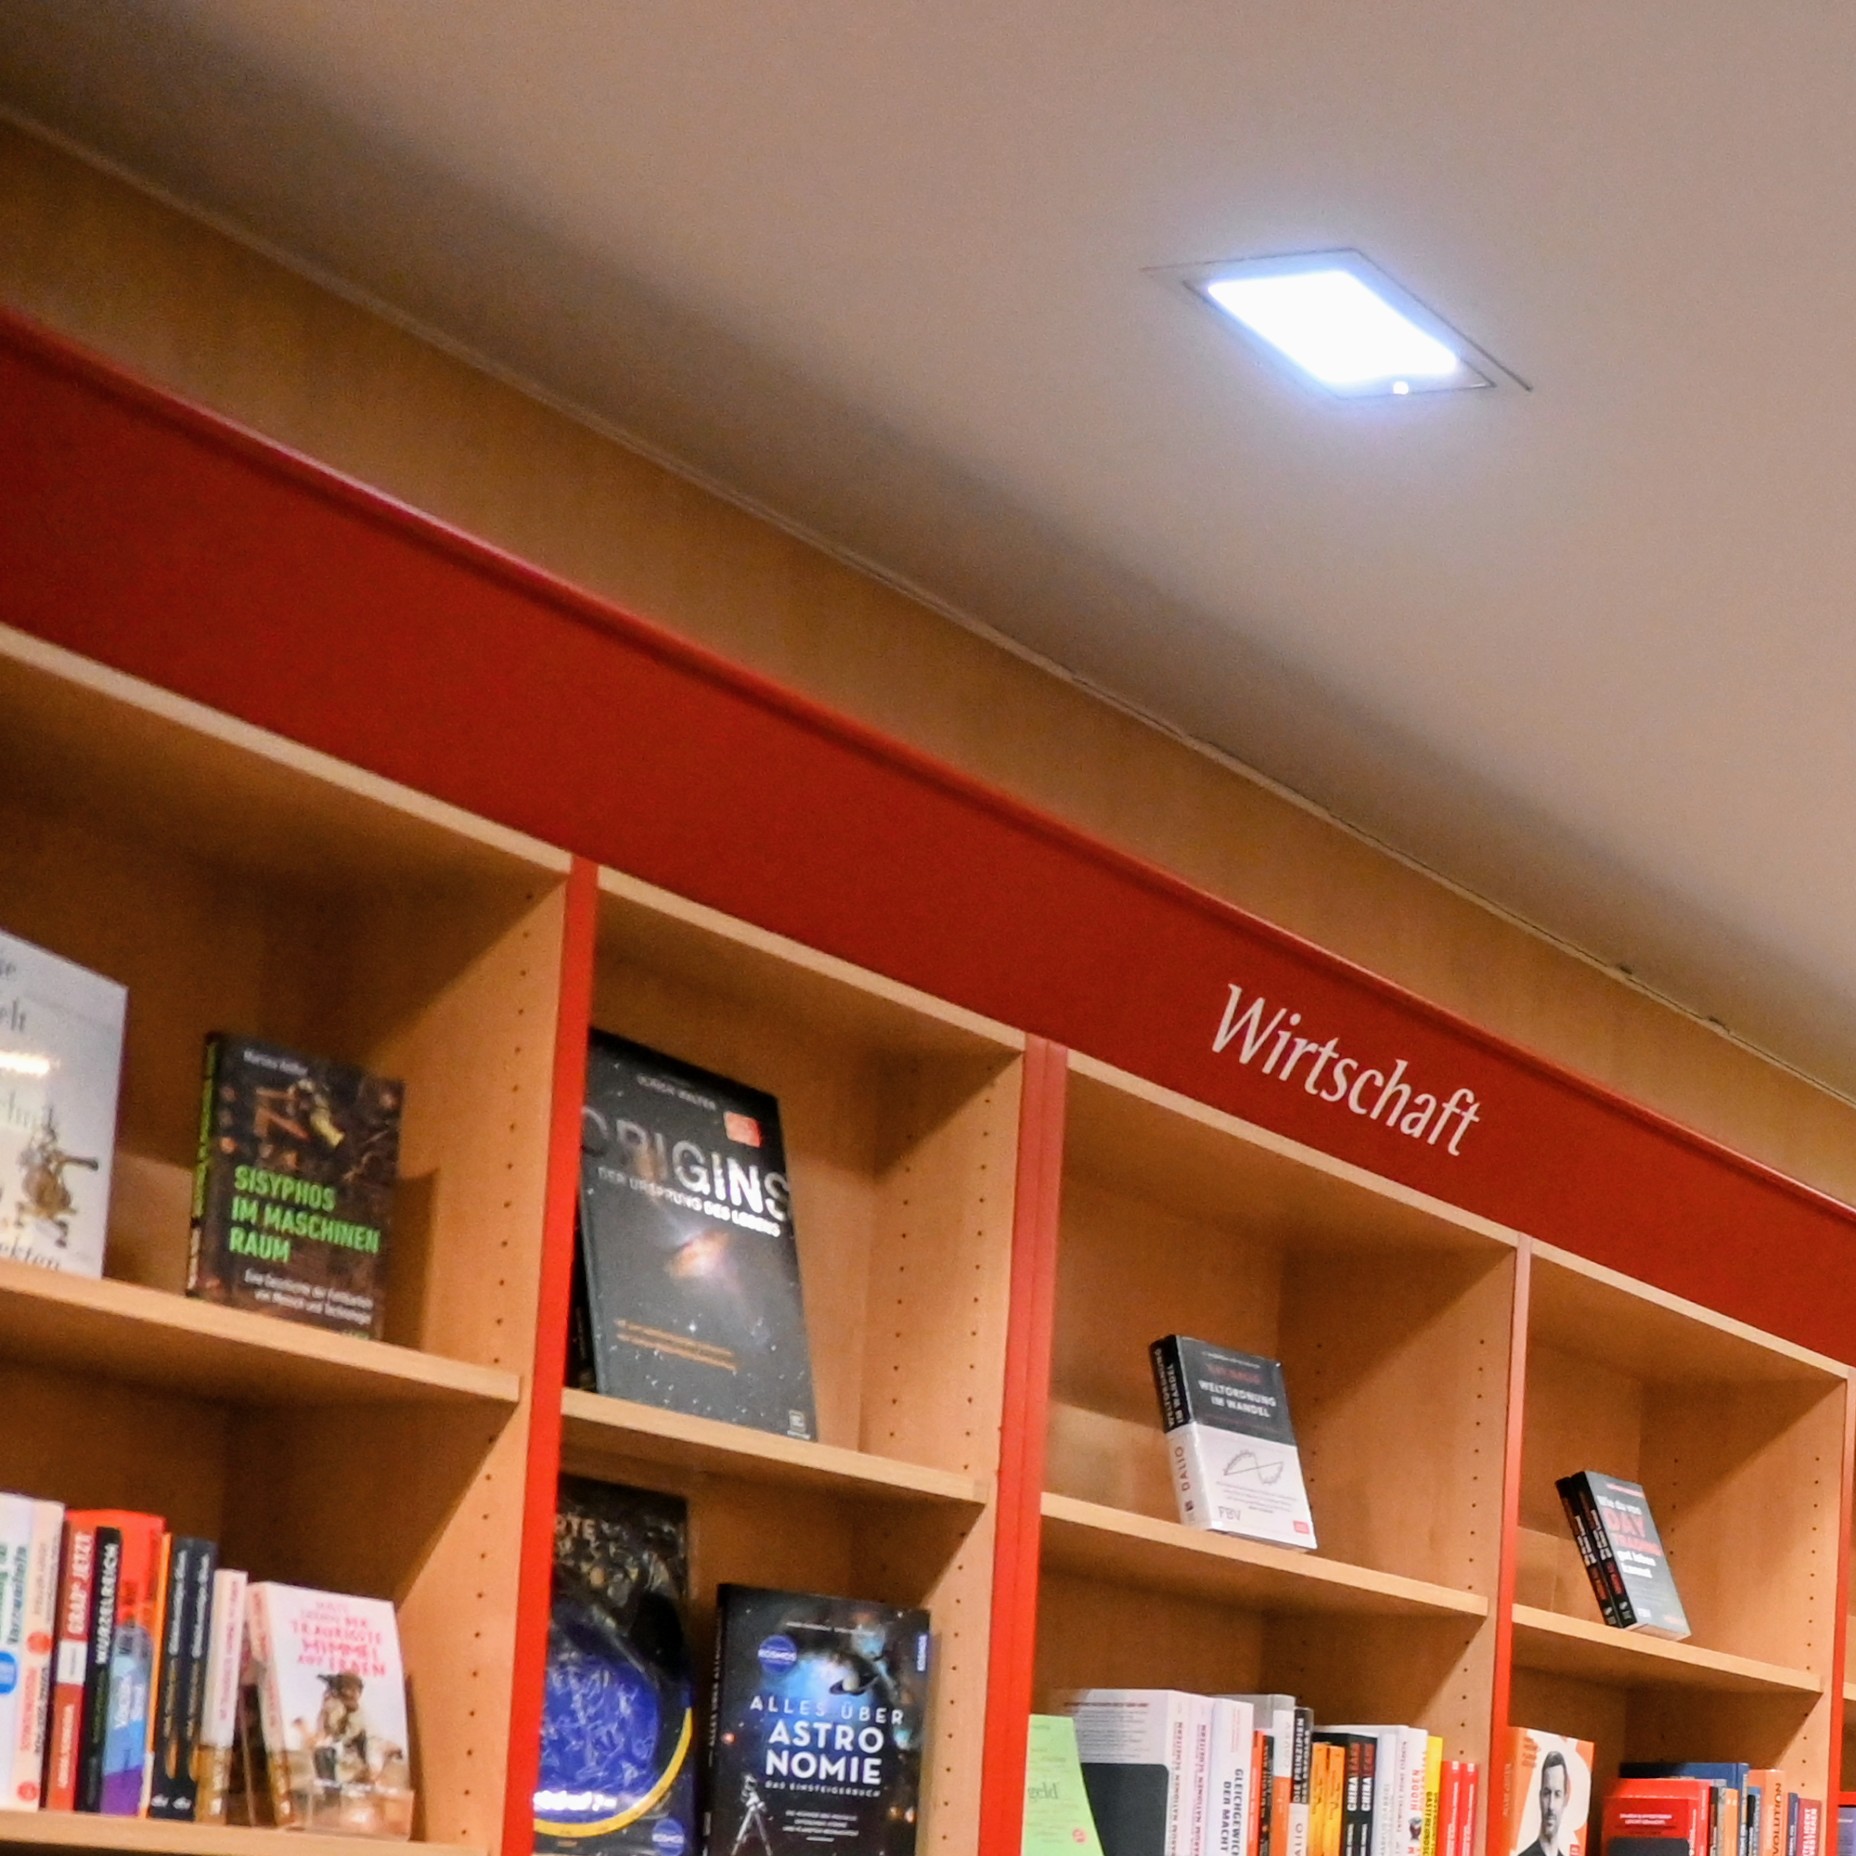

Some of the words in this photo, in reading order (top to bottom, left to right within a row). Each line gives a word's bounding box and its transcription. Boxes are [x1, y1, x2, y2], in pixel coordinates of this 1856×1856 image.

[1211, 983, 1480, 1157] Wirtschaft
[234, 1164, 337, 1212] SISYPHOS
[598, 1165, 627, 1184] DER
[629, 1177, 702, 1212] URSPRUNG
[703, 1199, 731, 1221] DES
[231, 1196, 260, 1226] IM
[263, 1204, 382, 1255] MASCHINEN
[229, 1226, 292, 1264] RAUM
[1198, 1380, 1277, 1407] WELTORDNUNG
[1227, 1399, 1270, 1418] WANDEL
[1174, 1446, 1191, 1492] DALIO
[1218, 1505, 1241, 1521] FBV
[1603, 1508, 1646, 1538] DAY
[757, 1648, 797, 1662] KOSMOS
[750, 1695, 826, 1718] ALLES
[840, 1701, 905, 1726] ÜBER
[768, 1718, 885, 1754] ASTRO
[764, 1748, 883, 1785] NOMIE
[1223, 1780, 1231, 1802] DER
[1219, 1805, 1230, 1853] MACHT
